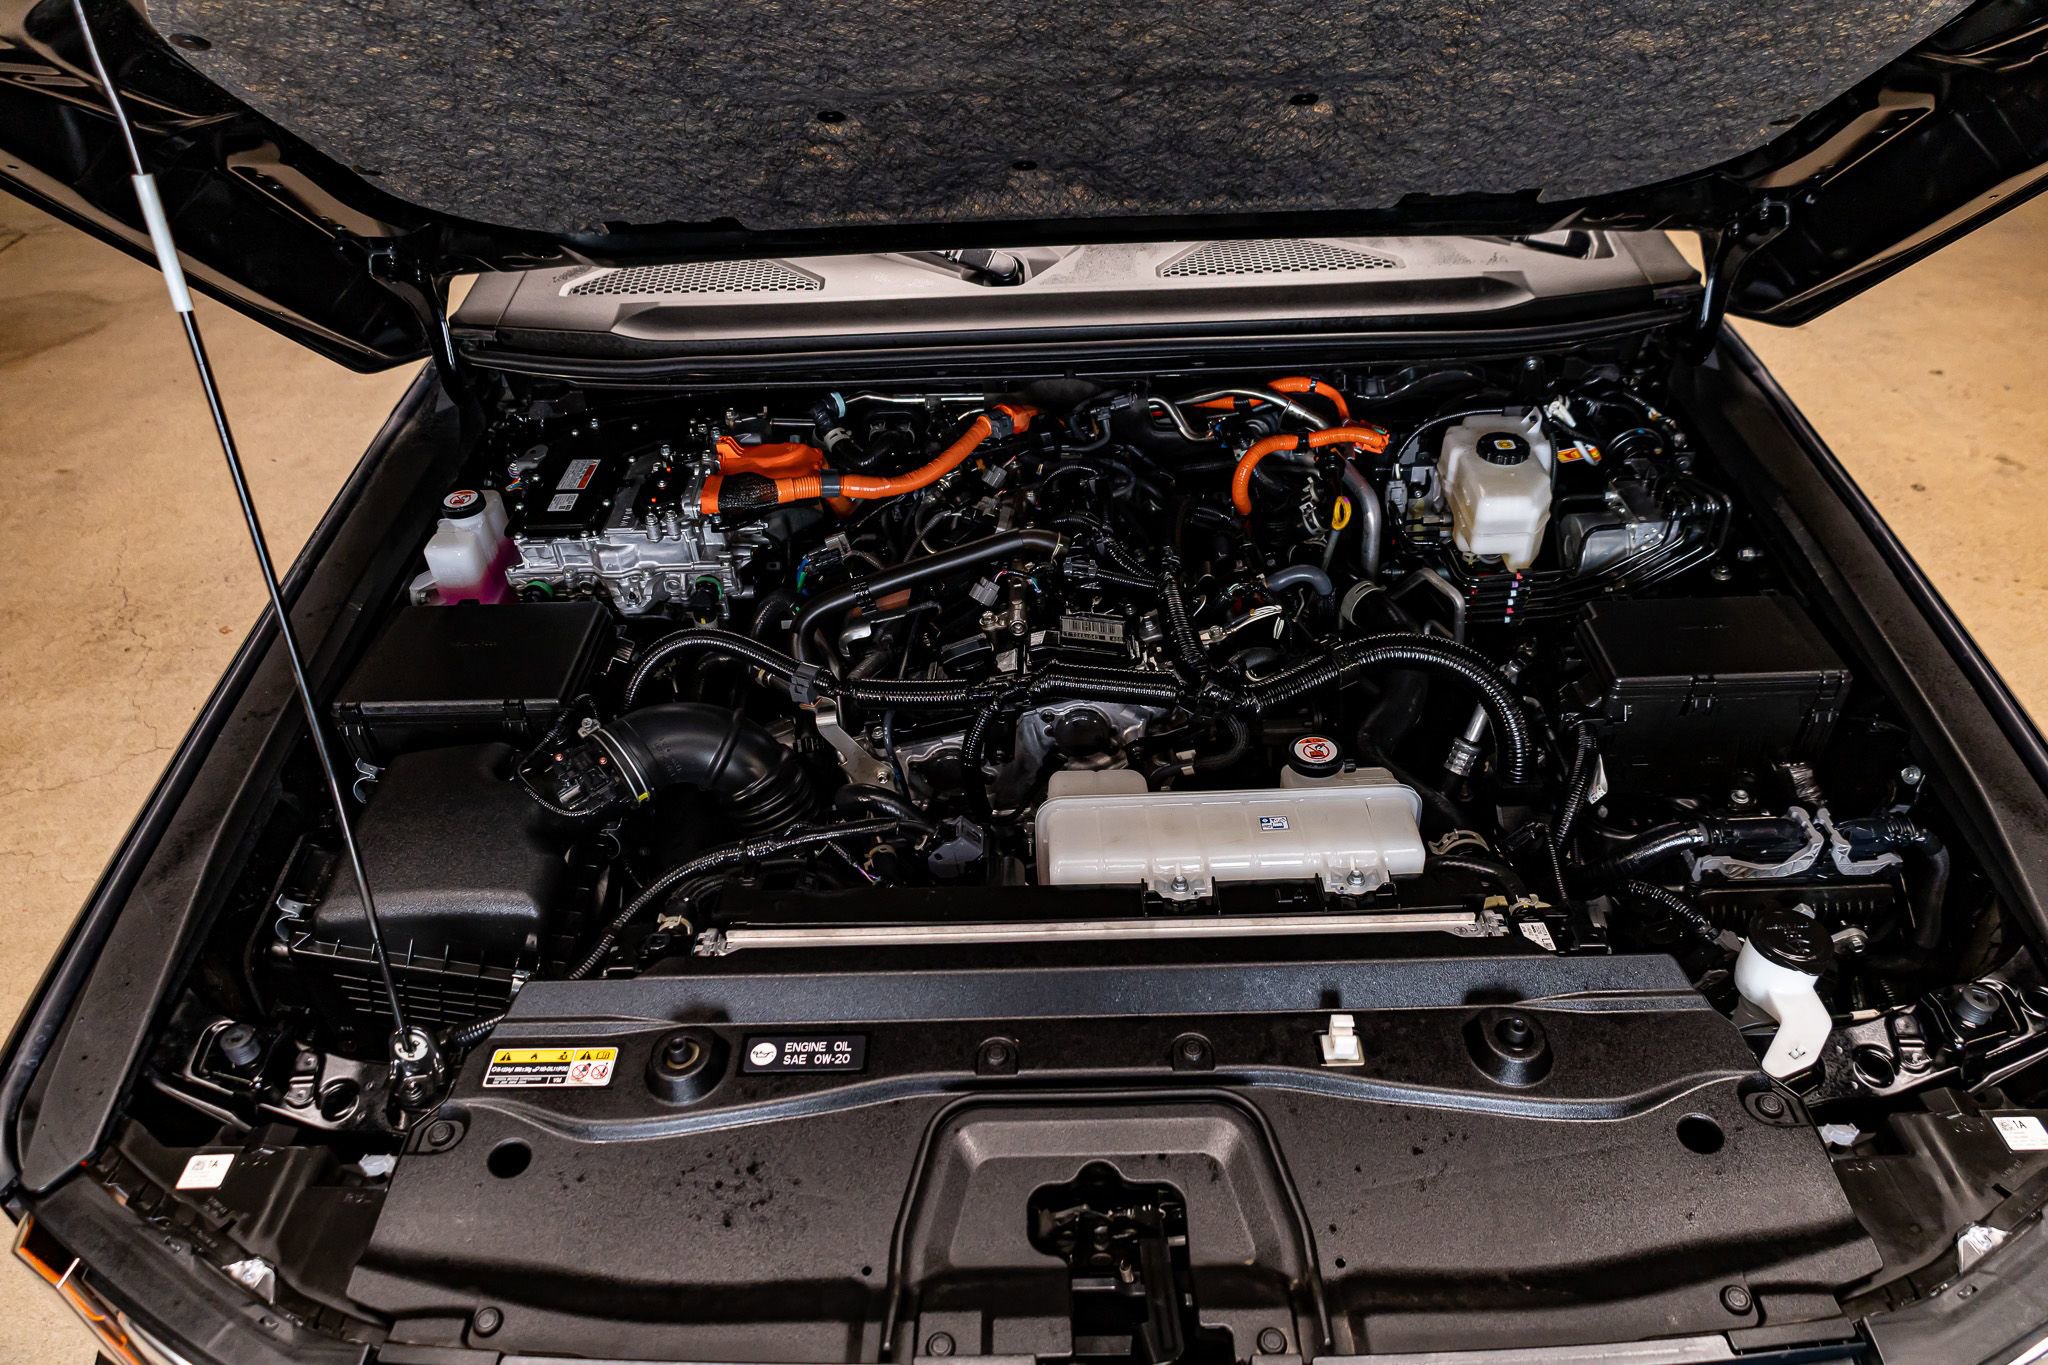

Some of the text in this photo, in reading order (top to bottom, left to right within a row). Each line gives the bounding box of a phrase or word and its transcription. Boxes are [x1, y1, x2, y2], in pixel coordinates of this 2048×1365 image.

[784, 1041, 852, 1053] ENGINE OIL
[782, 1054, 808, 1065] SAE
